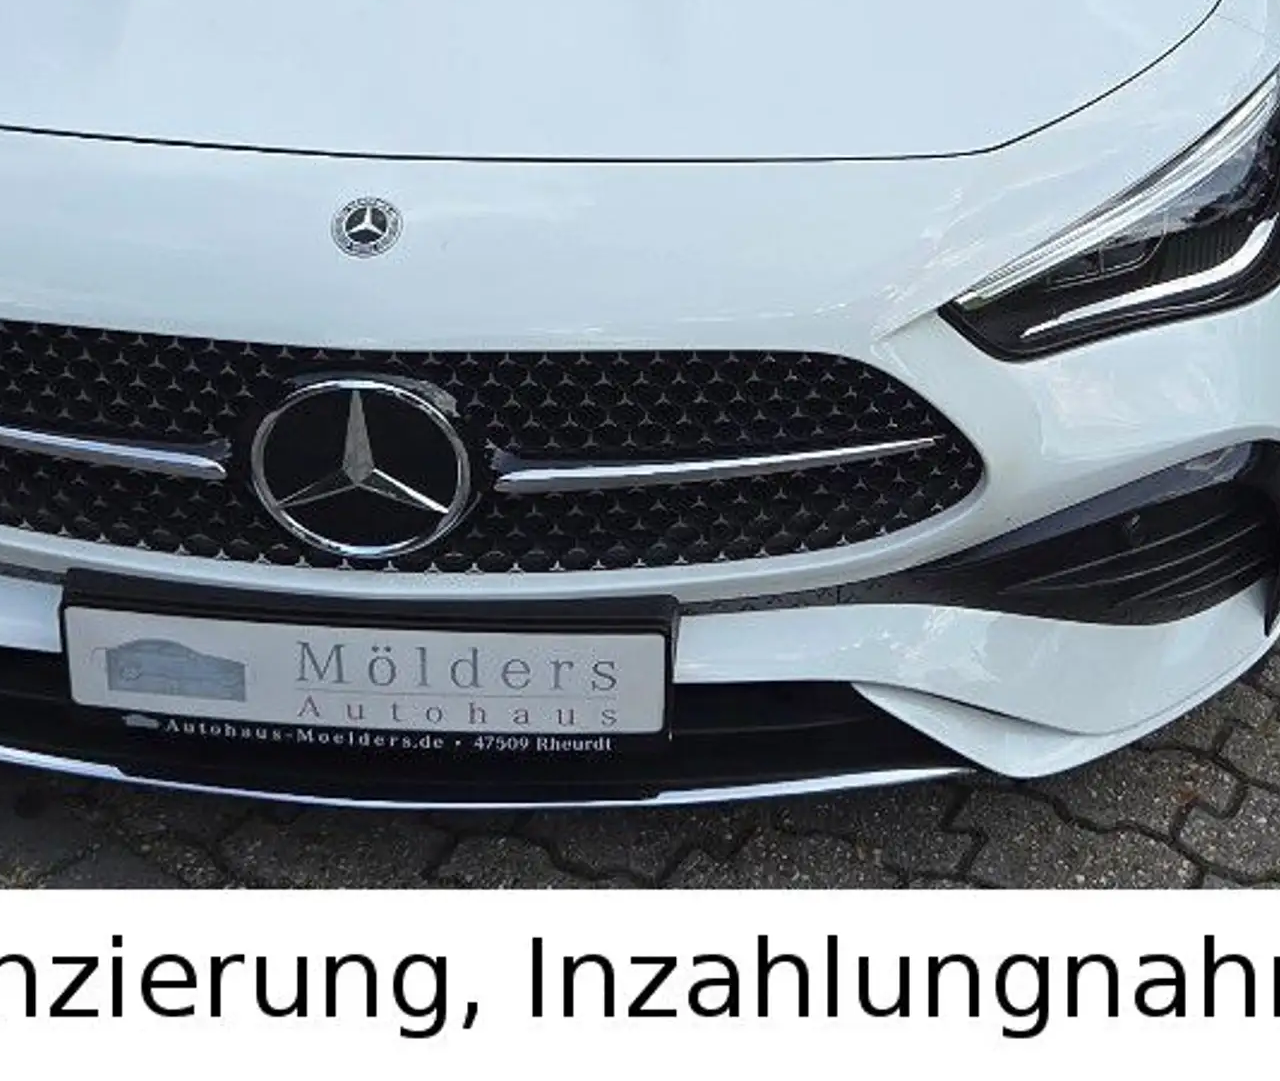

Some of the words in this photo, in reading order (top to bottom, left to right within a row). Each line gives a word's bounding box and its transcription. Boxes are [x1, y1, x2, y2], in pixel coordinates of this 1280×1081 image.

[296, 640, 619, 692] Mölders
[296, 695, 618, 727] Autohaus
[164, 719, 445, 751] Autohaus-Moelders.de
[473, 734, 529, 751] 47509
[536, 734, 613, 752] Rheurdt
